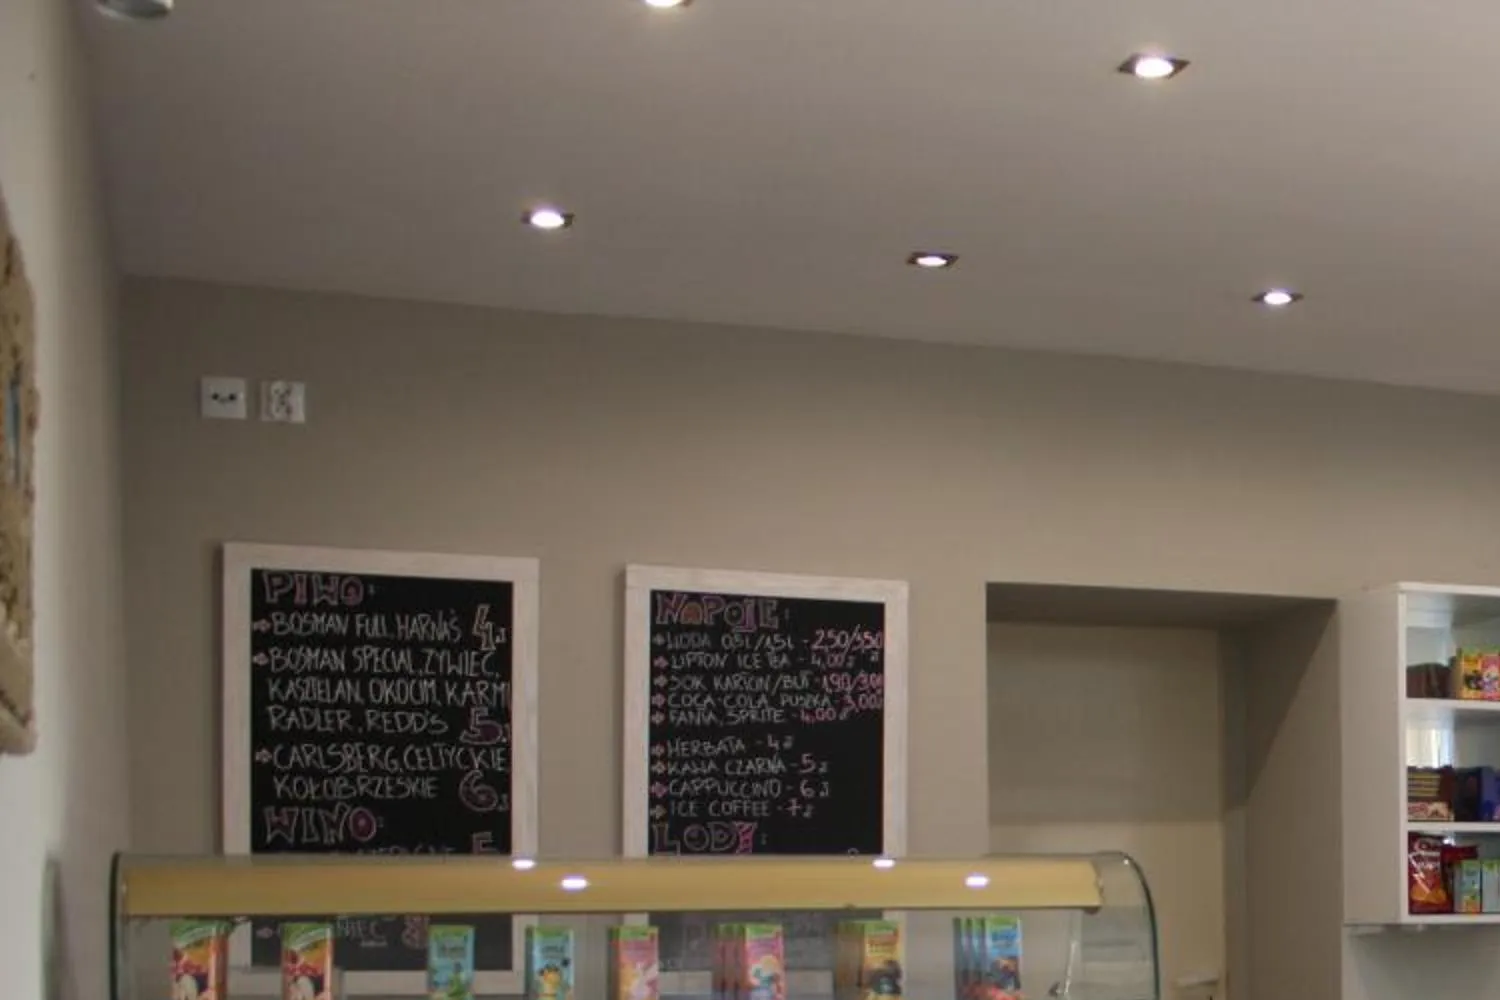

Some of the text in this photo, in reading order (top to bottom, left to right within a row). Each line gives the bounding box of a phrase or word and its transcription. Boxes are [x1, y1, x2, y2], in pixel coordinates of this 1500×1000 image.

[271, 611, 349, 636] BOSMAN
[268, 645, 347, 673] BOSMAN
[403, 743, 506, 772] CELTYCKIE
[667, 736, 745, 757] HERBATA
[668, 760, 718, 775] KAWA
[669, 776, 781, 800] CAPPUCCINO
[671, 800, 698, 817] ICE
[708, 799, 770, 817] COFFEE
